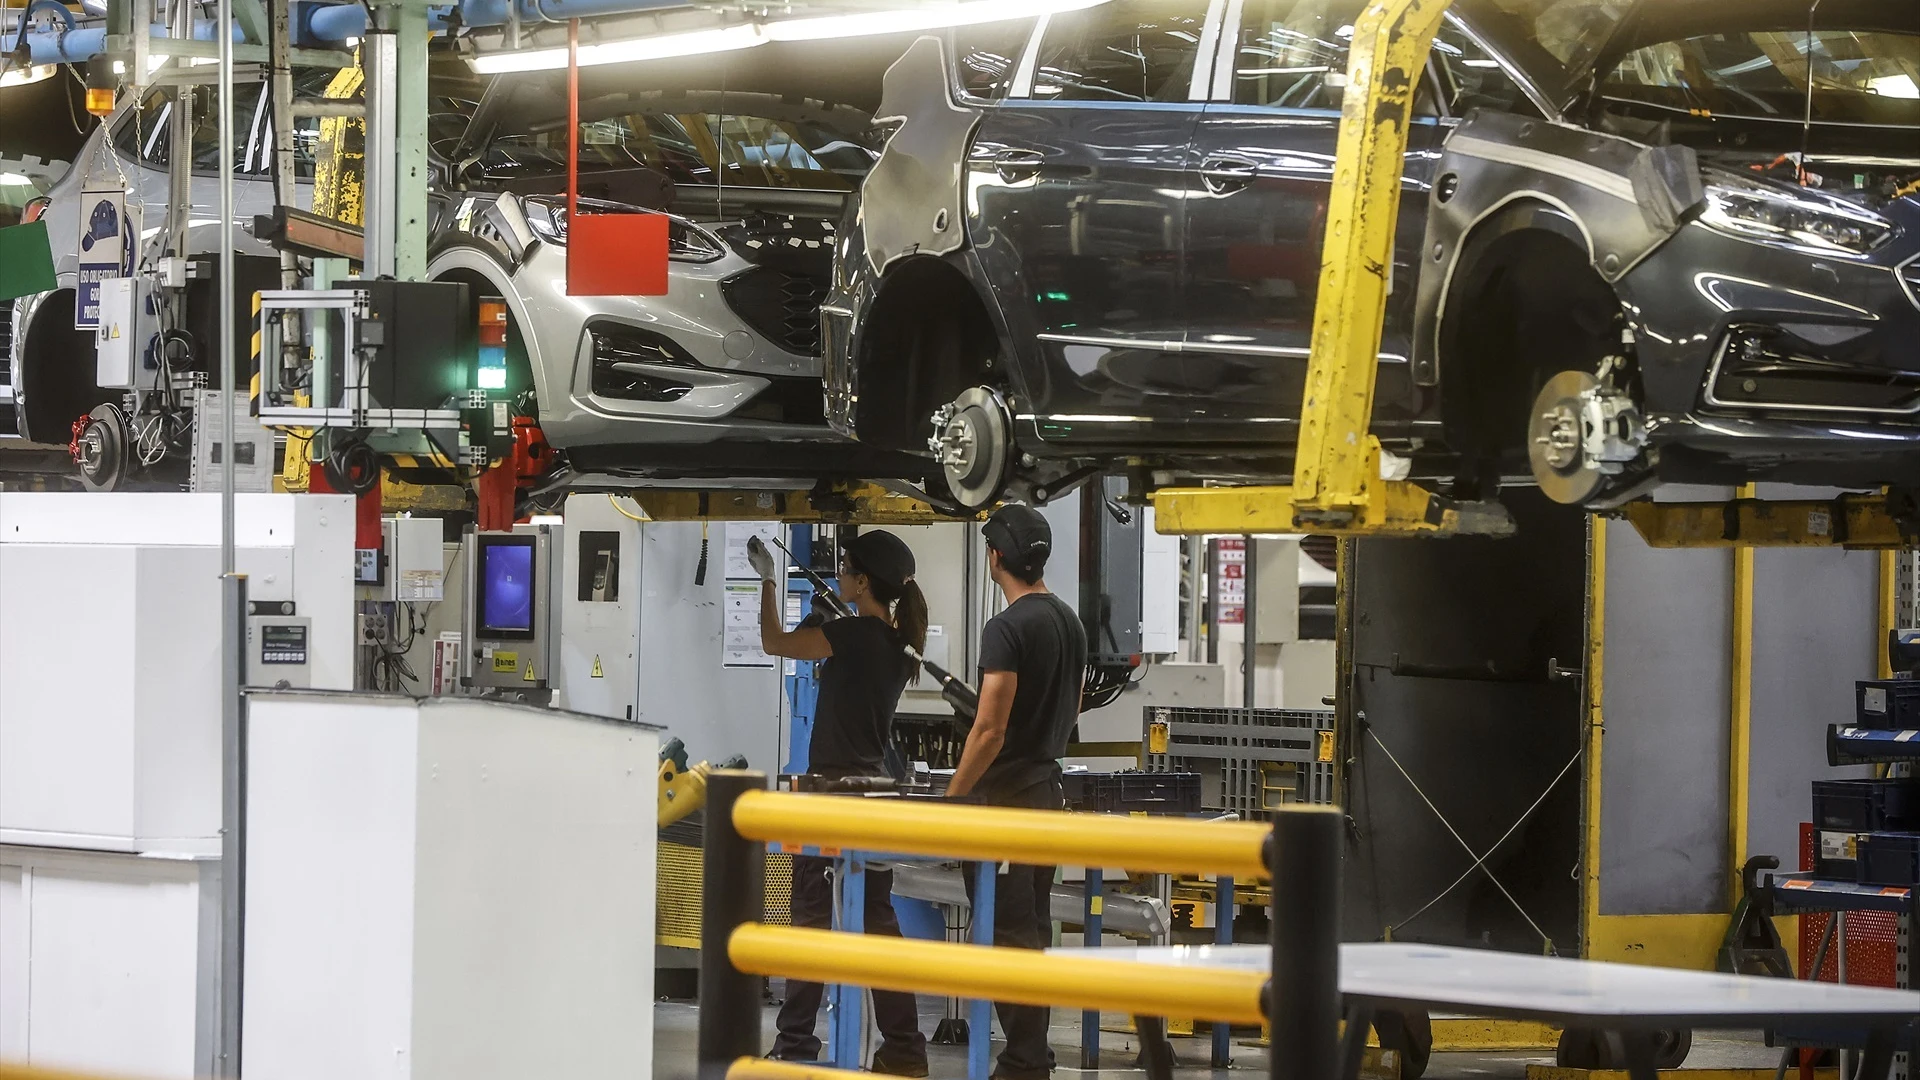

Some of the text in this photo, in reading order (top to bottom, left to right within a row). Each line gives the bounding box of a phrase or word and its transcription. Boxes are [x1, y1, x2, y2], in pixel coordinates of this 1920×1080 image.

[80, 270, 89, 283] USO
[90, 287, 100, 301] GOR
[83, 305, 100, 319] PROTEC
